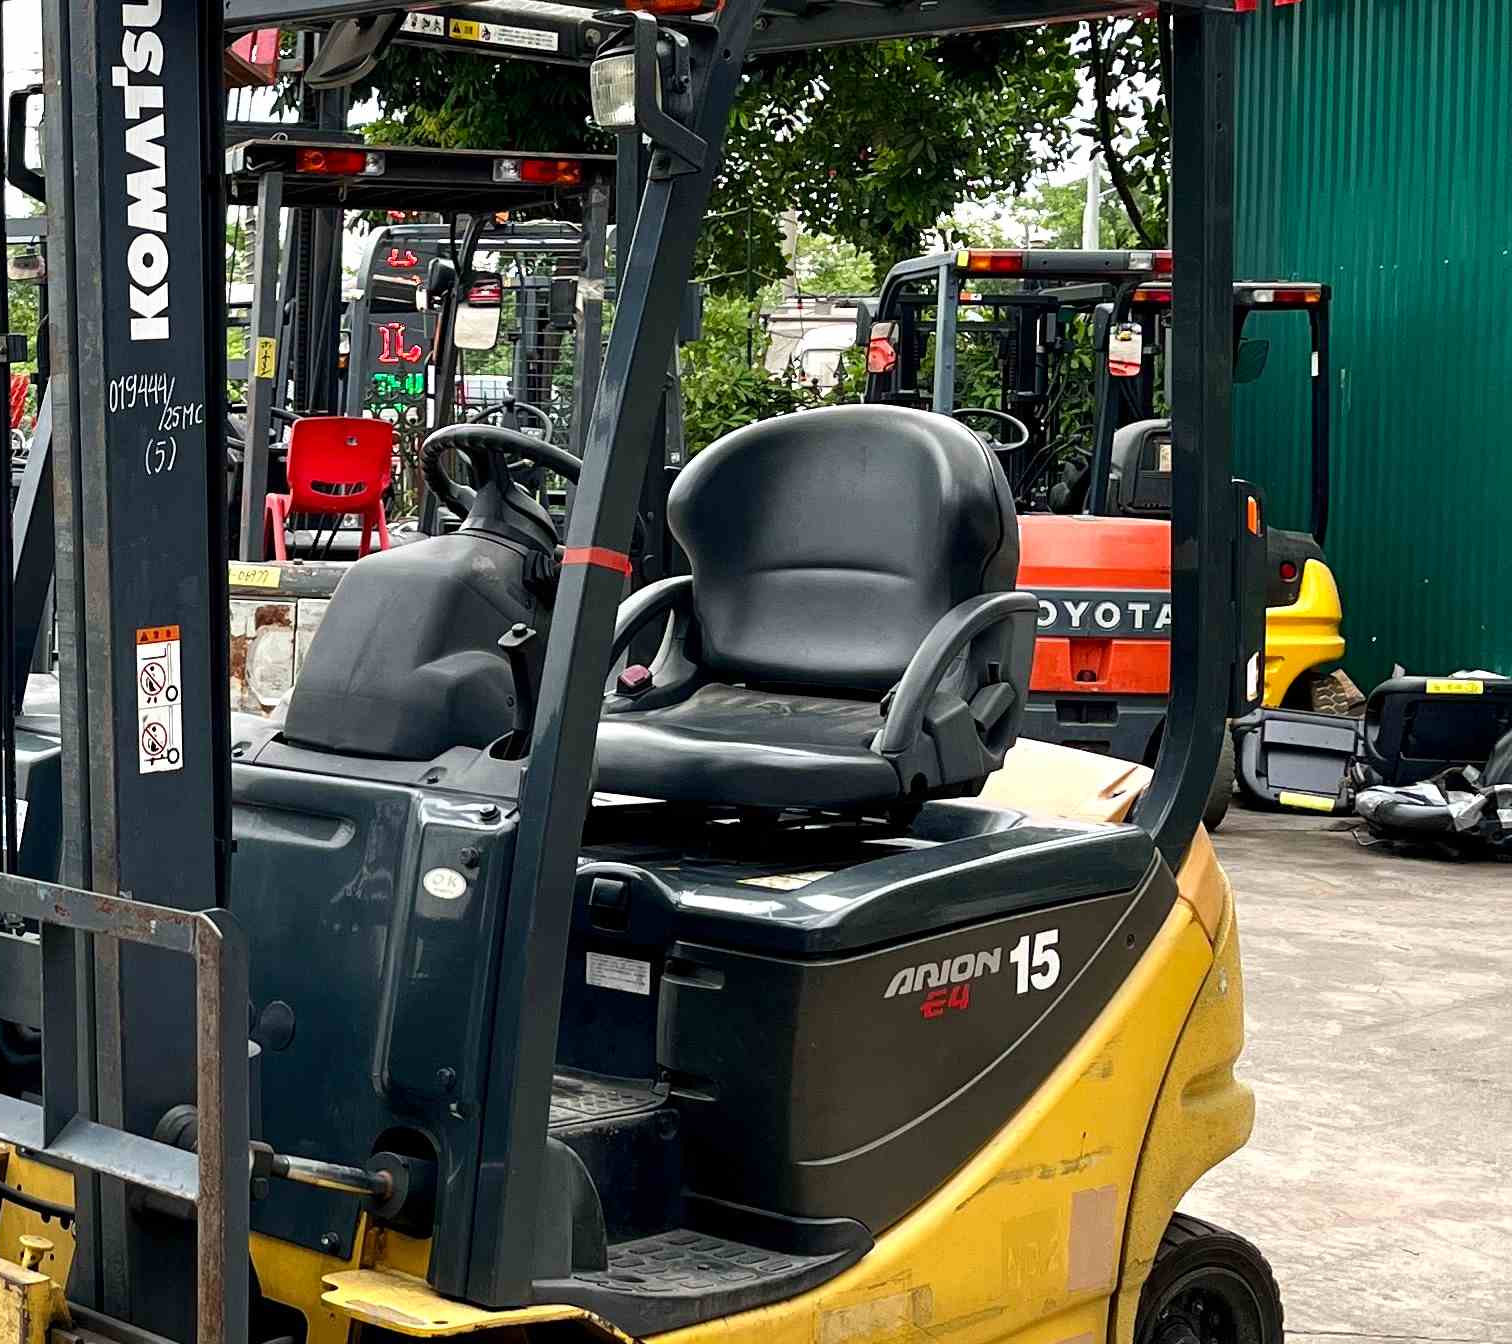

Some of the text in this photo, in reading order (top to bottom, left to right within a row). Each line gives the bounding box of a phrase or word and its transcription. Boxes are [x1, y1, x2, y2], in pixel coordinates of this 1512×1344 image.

[145, 436, 177, 475] (5)
[1037, 599, 1172, 629] OYOTA
[884, 928, 1061, 998] ARION 15
[920, 984, 969, 1018] E4
